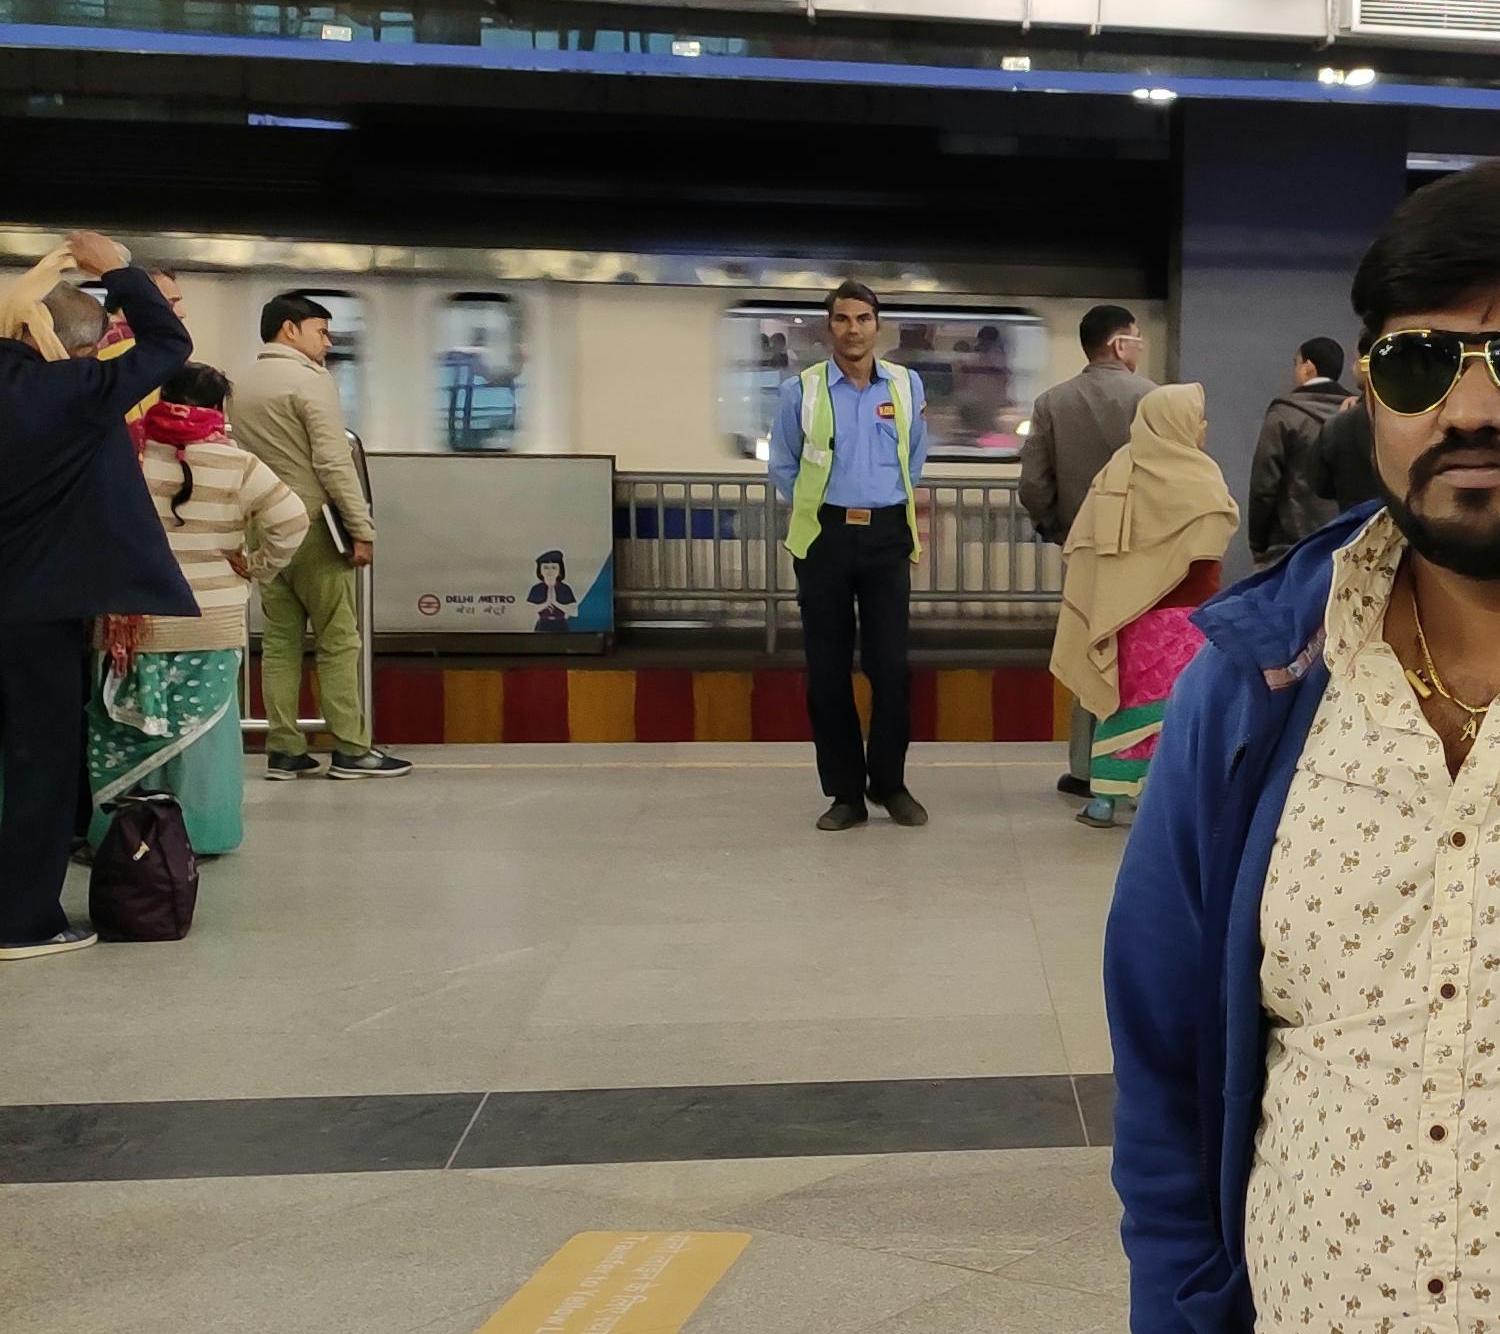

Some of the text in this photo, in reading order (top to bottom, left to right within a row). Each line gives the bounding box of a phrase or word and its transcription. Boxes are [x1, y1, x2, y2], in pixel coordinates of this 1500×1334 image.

[445, 595, 516, 604] DELHI METRO
[545, 1290, 599, 1325] Yellow
